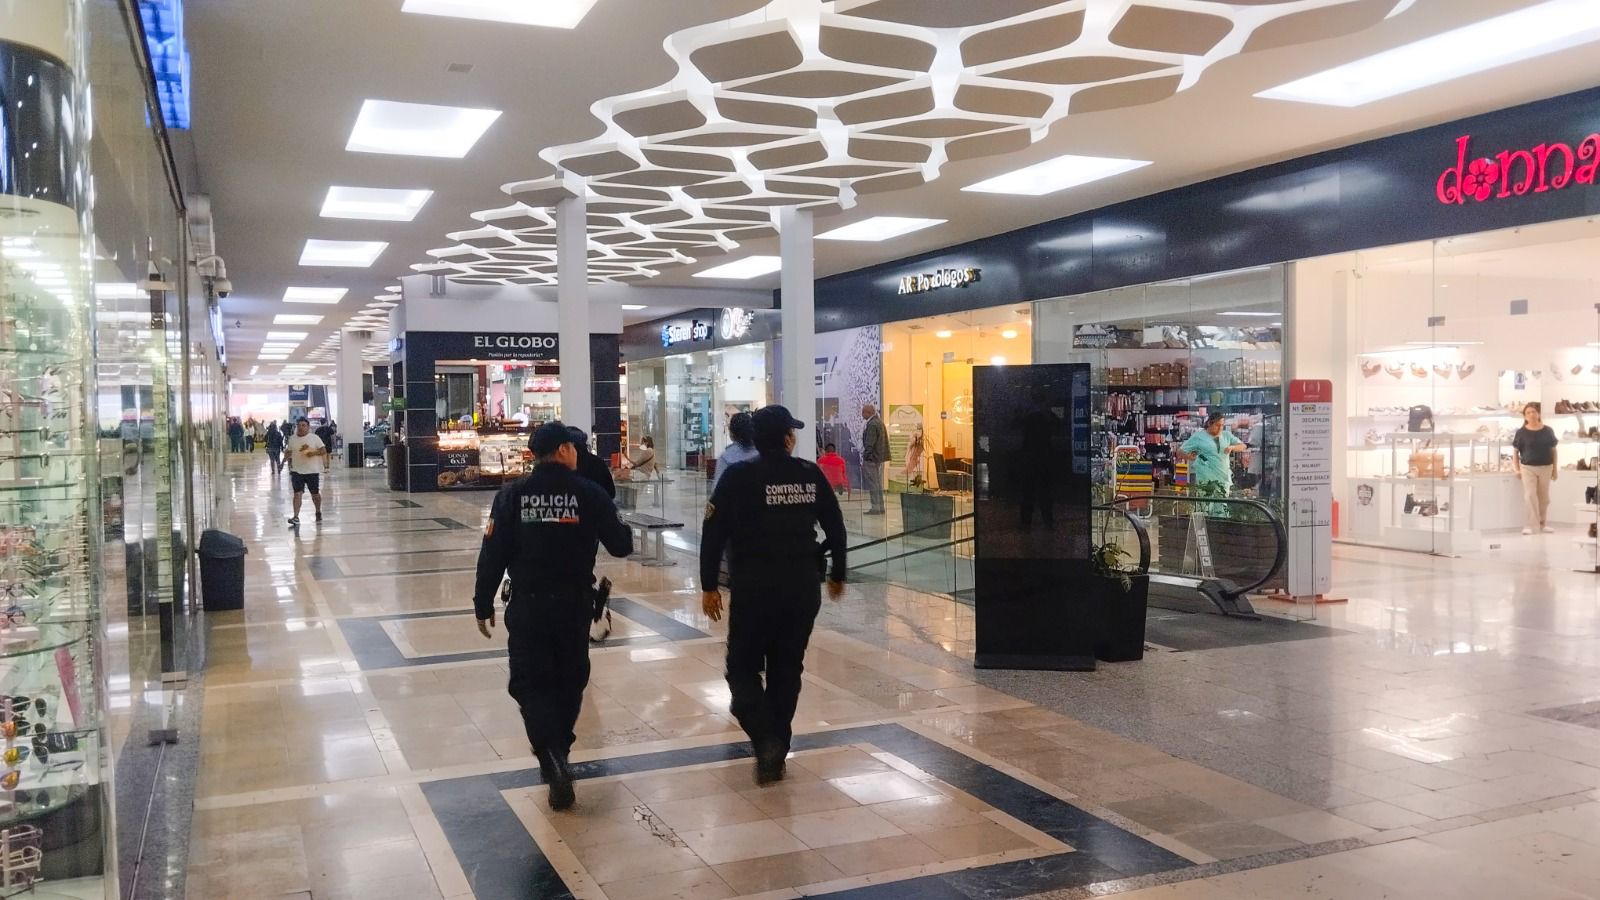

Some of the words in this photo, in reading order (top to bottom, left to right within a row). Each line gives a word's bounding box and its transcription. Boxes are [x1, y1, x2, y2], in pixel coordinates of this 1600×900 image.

[693, 321, 708, 338] shop
[474, 336, 494, 348] EL
[496, 336, 556, 348] GLOBO
[766, 483, 804, 495] CONTROL
[805, 483, 816, 493] DE
[520, 493, 579, 508] POLICÍA
[766, 493, 816, 505] EXPLOSIVOS
[520, 507, 579, 522] ESTATAL
